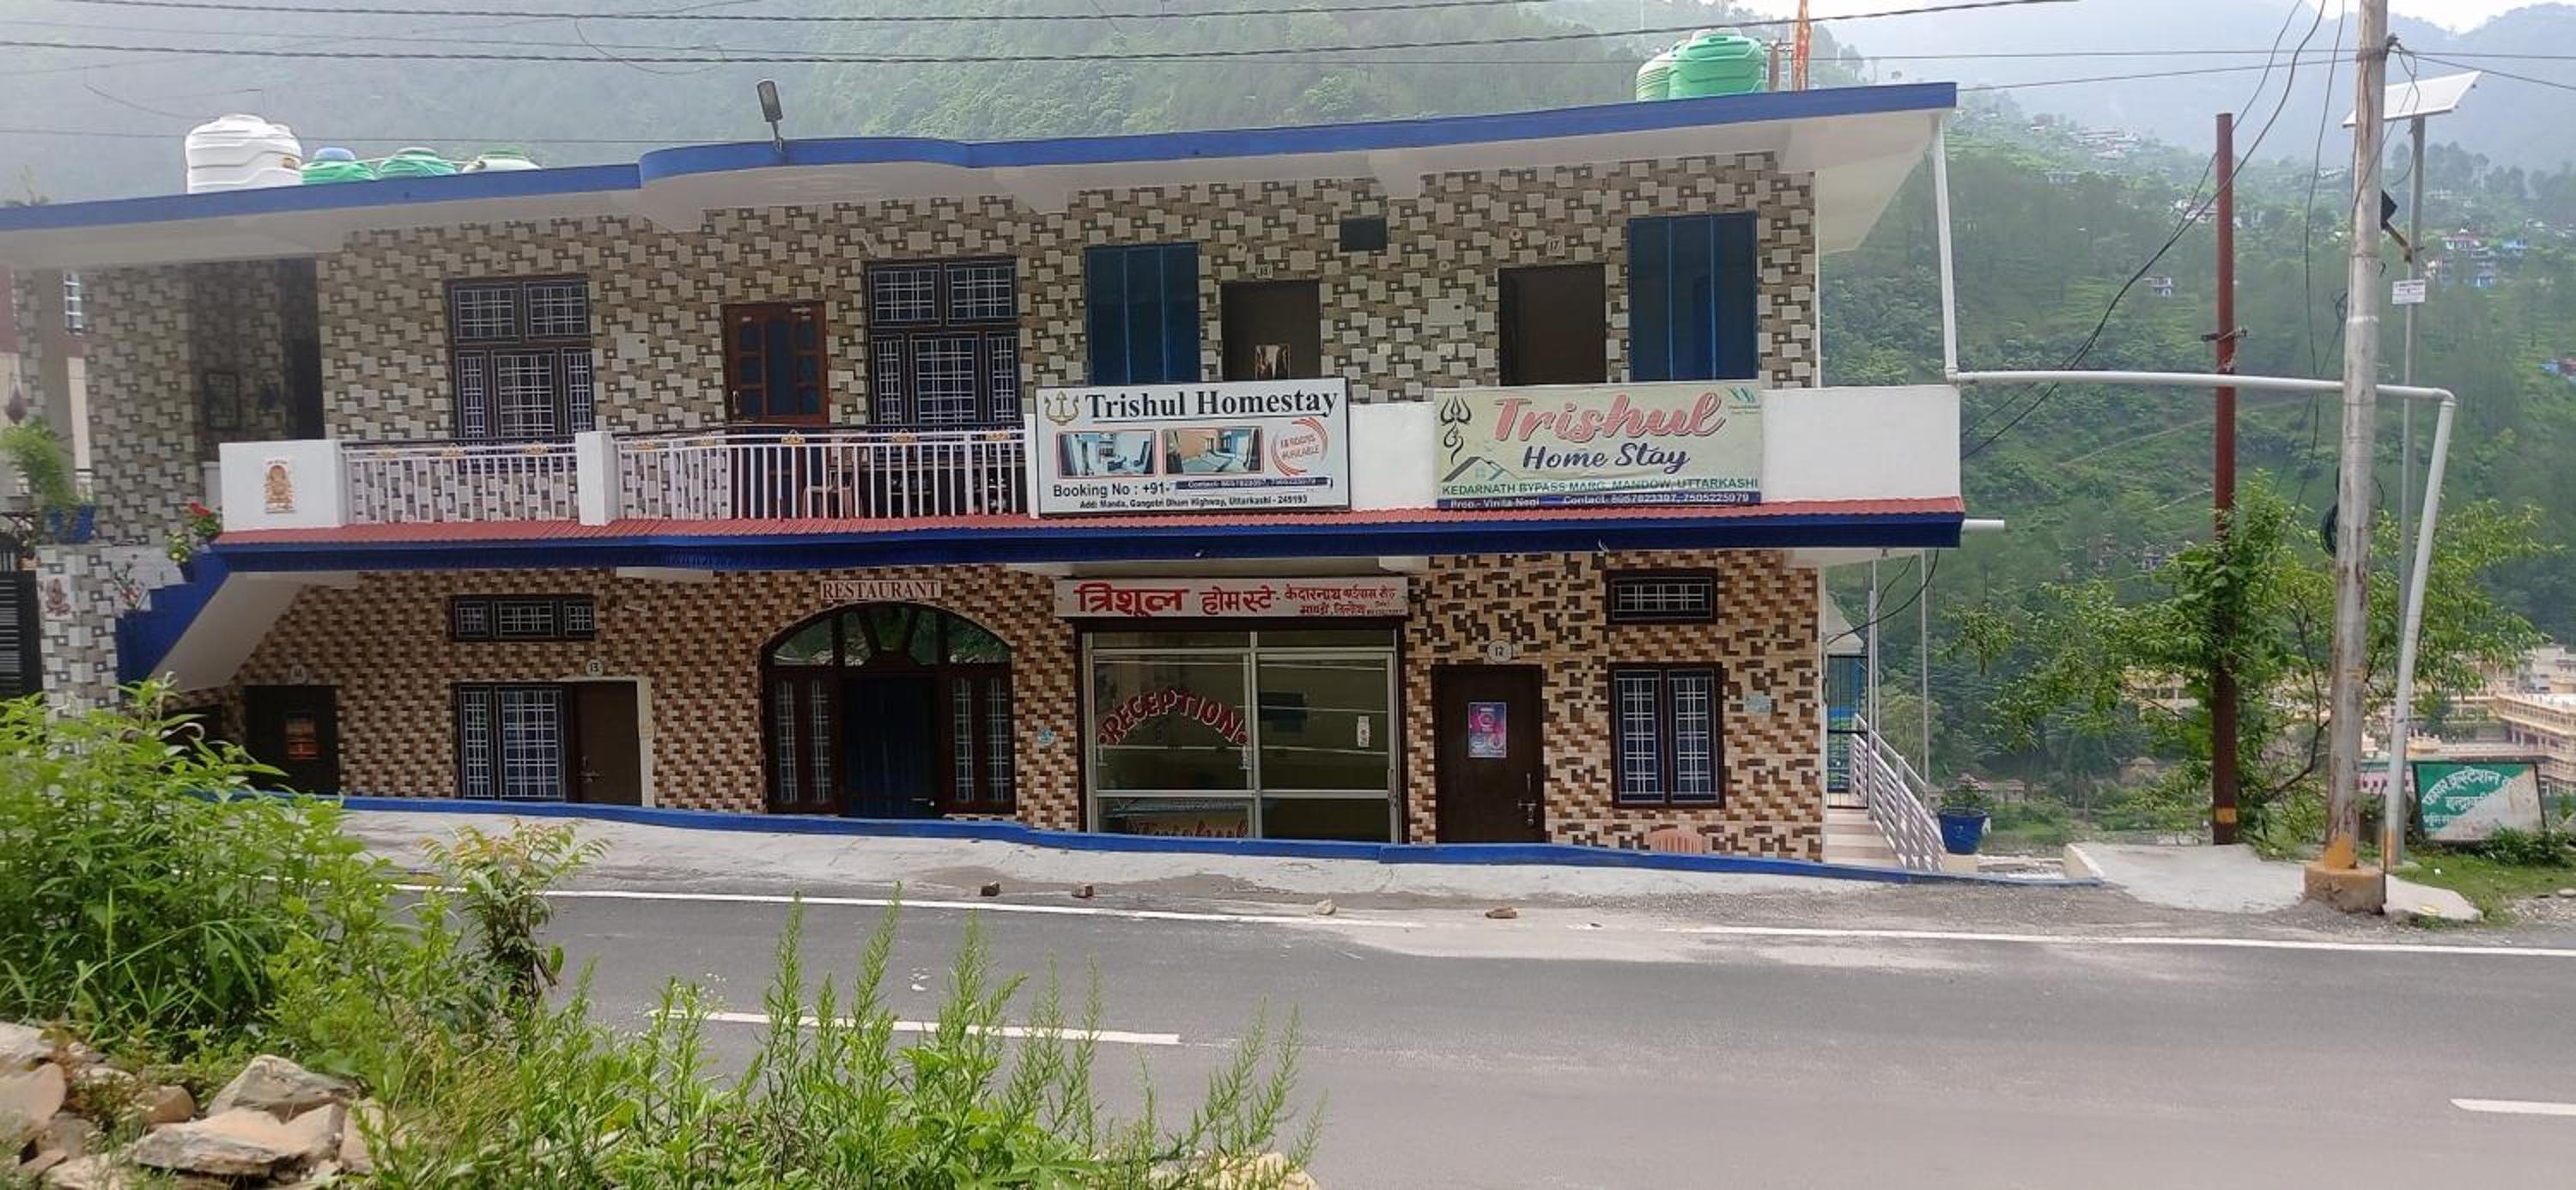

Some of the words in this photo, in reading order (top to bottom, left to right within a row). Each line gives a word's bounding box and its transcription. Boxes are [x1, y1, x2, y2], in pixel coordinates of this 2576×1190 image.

[1085, 391, 1186, 419] Trishul
[1196, 389, 1339, 418] Homestay
[1492, 392, 1727, 444] Trishul
[1522, 445, 1609, 470] Home
[1614, 442, 1691, 474] Stay
[1053, 483, 1108, 498] Booking
[1112, 483, 1131, 495] No
[1442, 483, 1516, 495] KEDARNATH
[1518, 481, 1565, 493] BYPASS
[1677, 477, 1759, 489] UTTARKASHI
[823, 580, 939, 598] RESTAURANT
[1073, 583, 1189, 616] त्रिशूल
[1199, 586, 1241, 615] होम
[1102, 687, 1244, 744] RECEPTION
